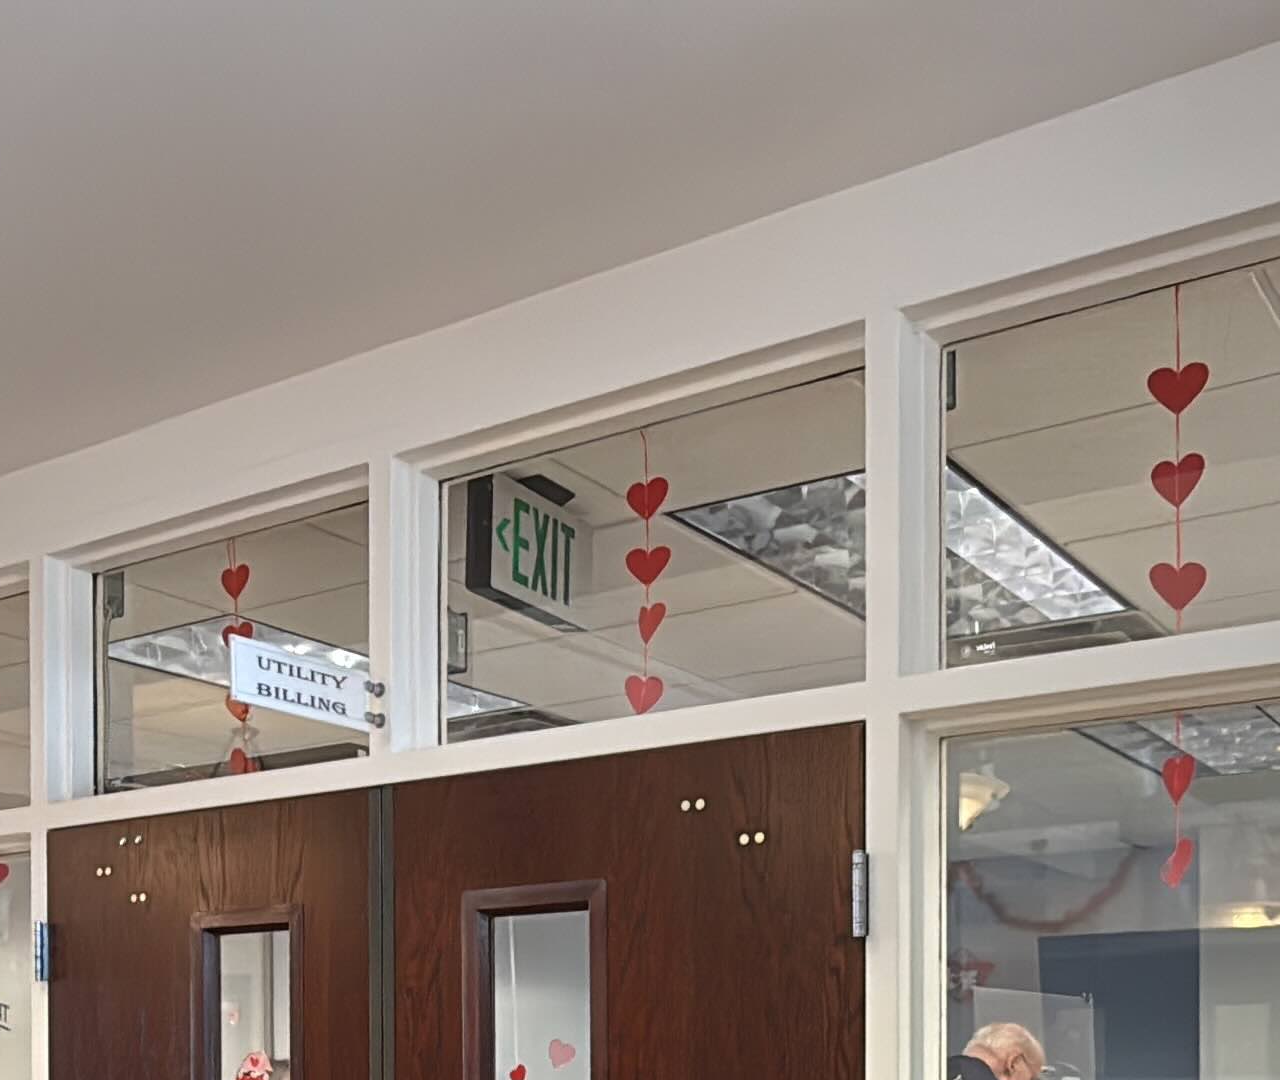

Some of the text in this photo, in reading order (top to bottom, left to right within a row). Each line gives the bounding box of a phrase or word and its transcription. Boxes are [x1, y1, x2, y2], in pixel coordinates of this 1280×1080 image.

[512, 498, 575, 606] EXIT
[256, 655, 348, 690] UTILITY
[256, 683, 348, 717] BILLING
